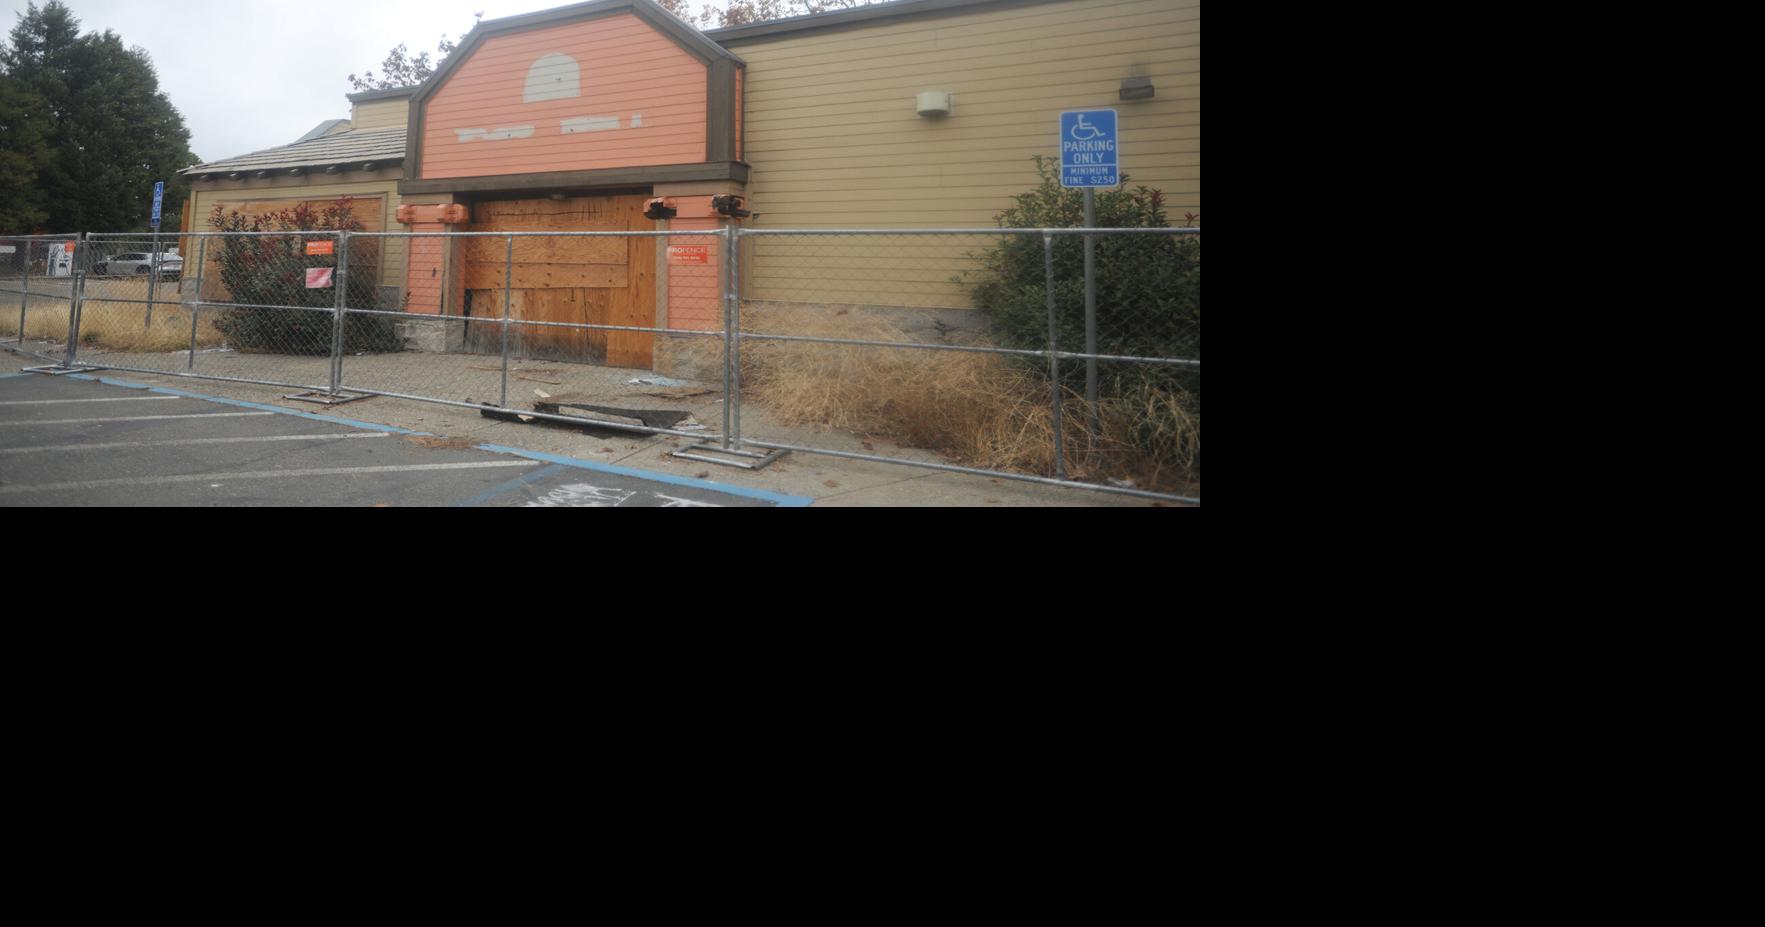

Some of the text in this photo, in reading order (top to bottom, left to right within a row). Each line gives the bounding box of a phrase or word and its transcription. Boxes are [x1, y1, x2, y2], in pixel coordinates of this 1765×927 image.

[1063, 140, 1114, 152] PARKING
[1073, 152, 1104, 164] ONLY
[1070, 167, 1108, 176] MINIMUM
[1064, 176, 1084, 184] FINE
